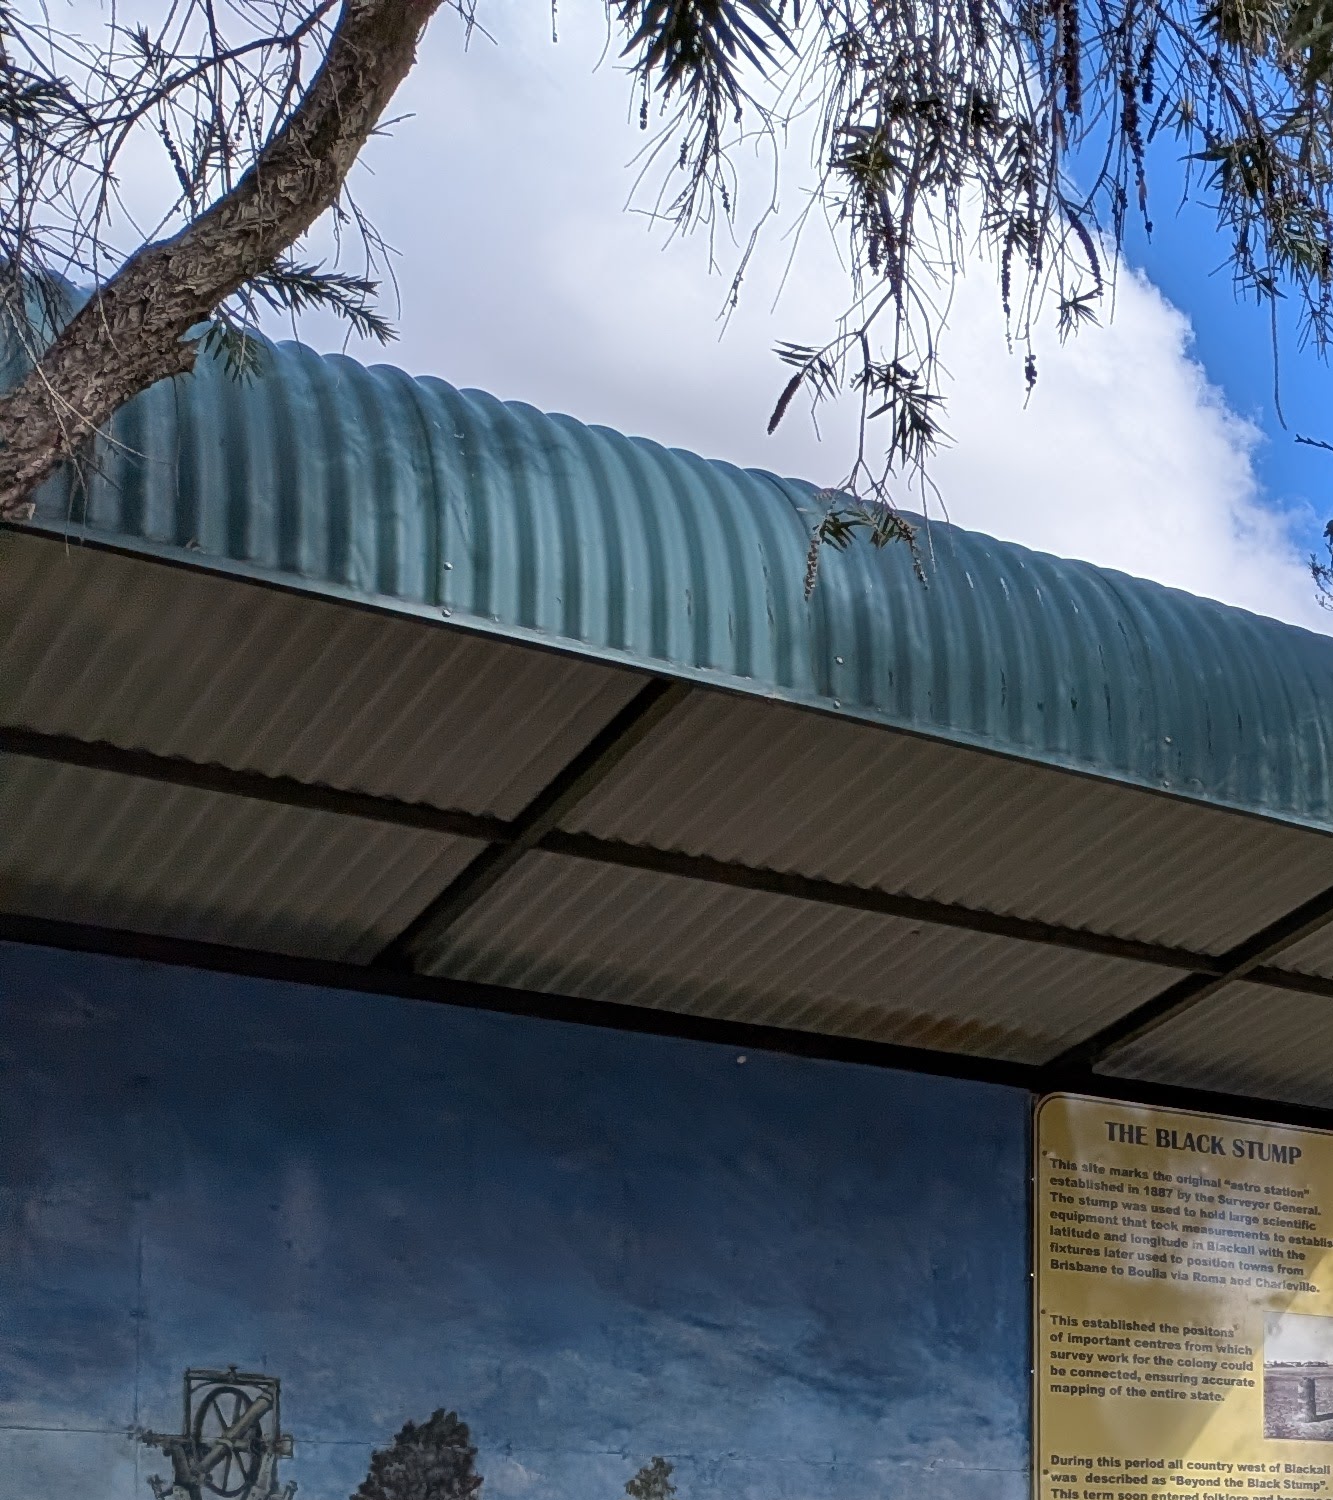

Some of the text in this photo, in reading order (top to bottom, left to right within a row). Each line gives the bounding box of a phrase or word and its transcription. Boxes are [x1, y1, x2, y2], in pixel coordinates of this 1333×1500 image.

[1105, 1121, 1301, 1164] THE BLACK STUMP
[1052, 1313, 1078, 1326] This
[1082, 1316, 1155, 1332] established
[1159, 1321, 1179, 1334] the
[1050, 1330, 1252, 1355] of important centres from which
[1050, 1350, 1253, 1371] survey work for the colony could
[1050, 1364, 1255, 1388] be connected, ensuring accurate
[1050, 1381, 1224, 1401] mapping of the entire state.
[1050, 1454, 1330, 1475] During this period all country west of Blackall
[1051, 1473, 1077, 1483] was
[1085, 1472, 1148, 1485] described
[1151, 1476, 1166, 1485] as
[1224, 1475, 1243, 1487] the
[1247, 1476, 1280, 1489] Black
[1050, 1487, 1079, 1499] This
[1083, 1487, 1114, 1500] term
[1117, 1491, 1148, 1500] soon
